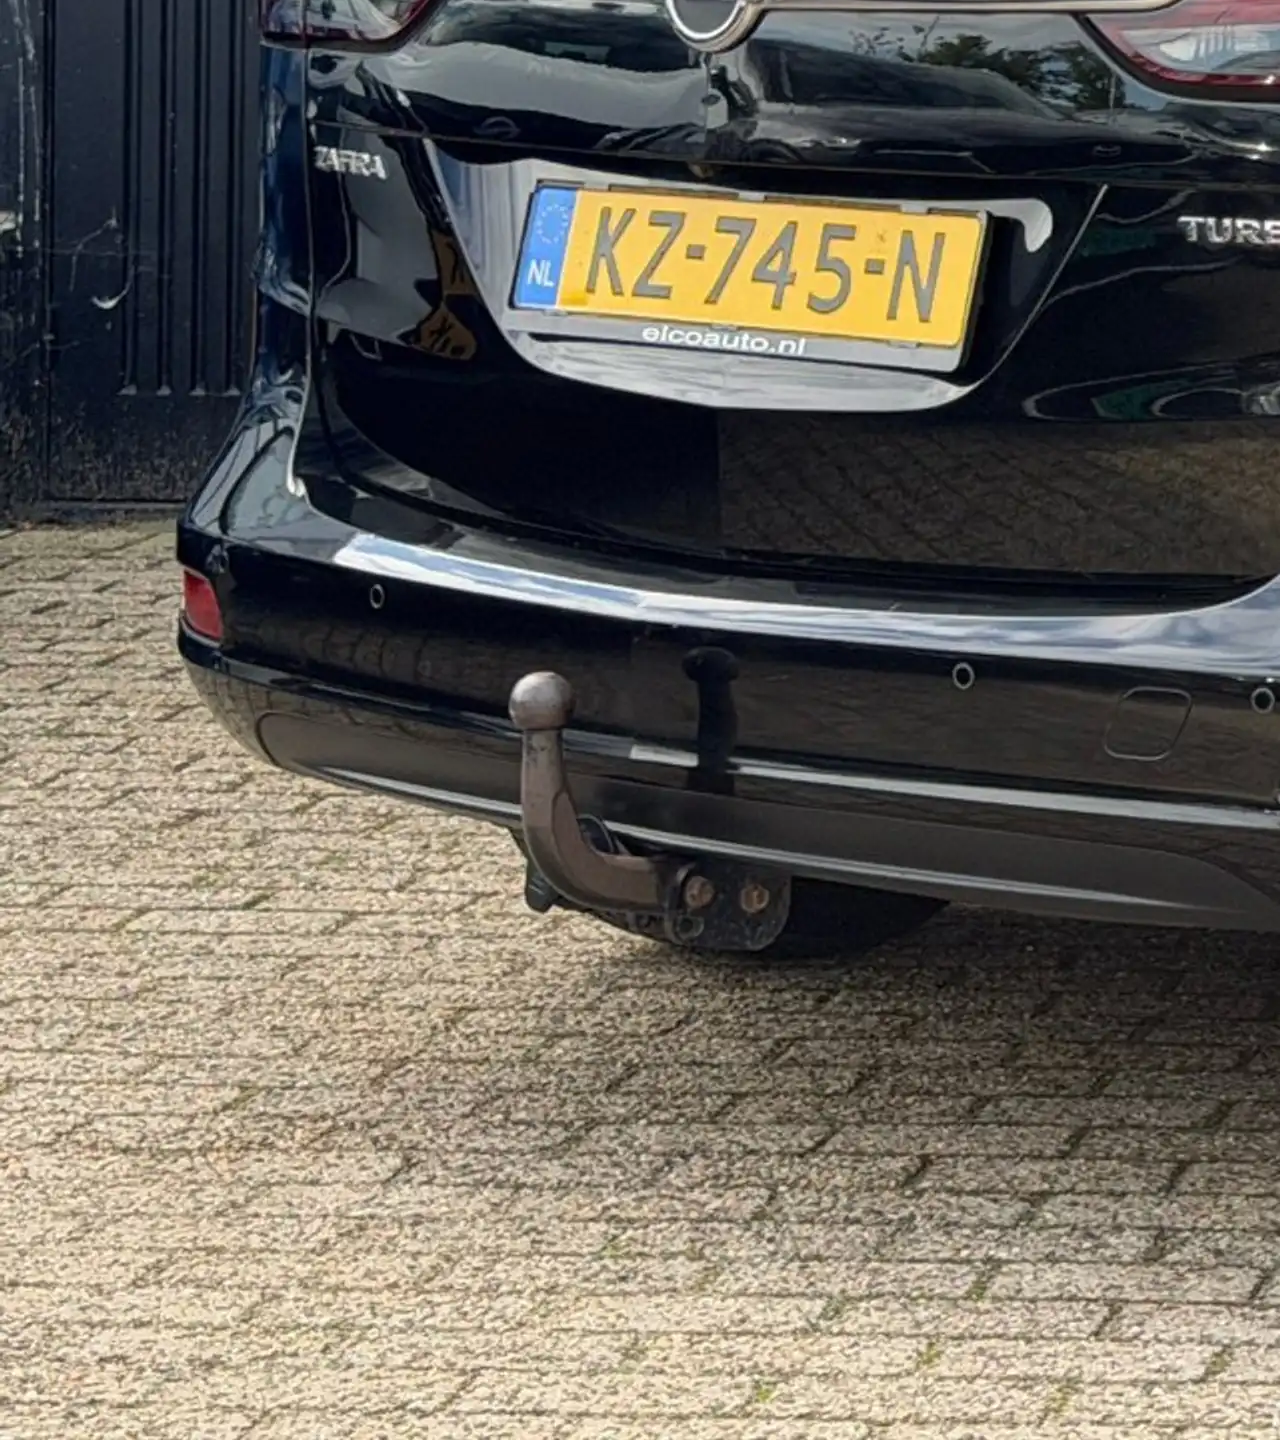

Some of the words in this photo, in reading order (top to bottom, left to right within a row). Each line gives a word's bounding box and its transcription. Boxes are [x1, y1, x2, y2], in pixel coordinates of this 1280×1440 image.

[527, 259, 555, 289] NL
[585, 206, 946, 324] KZ-745-N
[642, 324, 806, 356] elcoauto.nl
